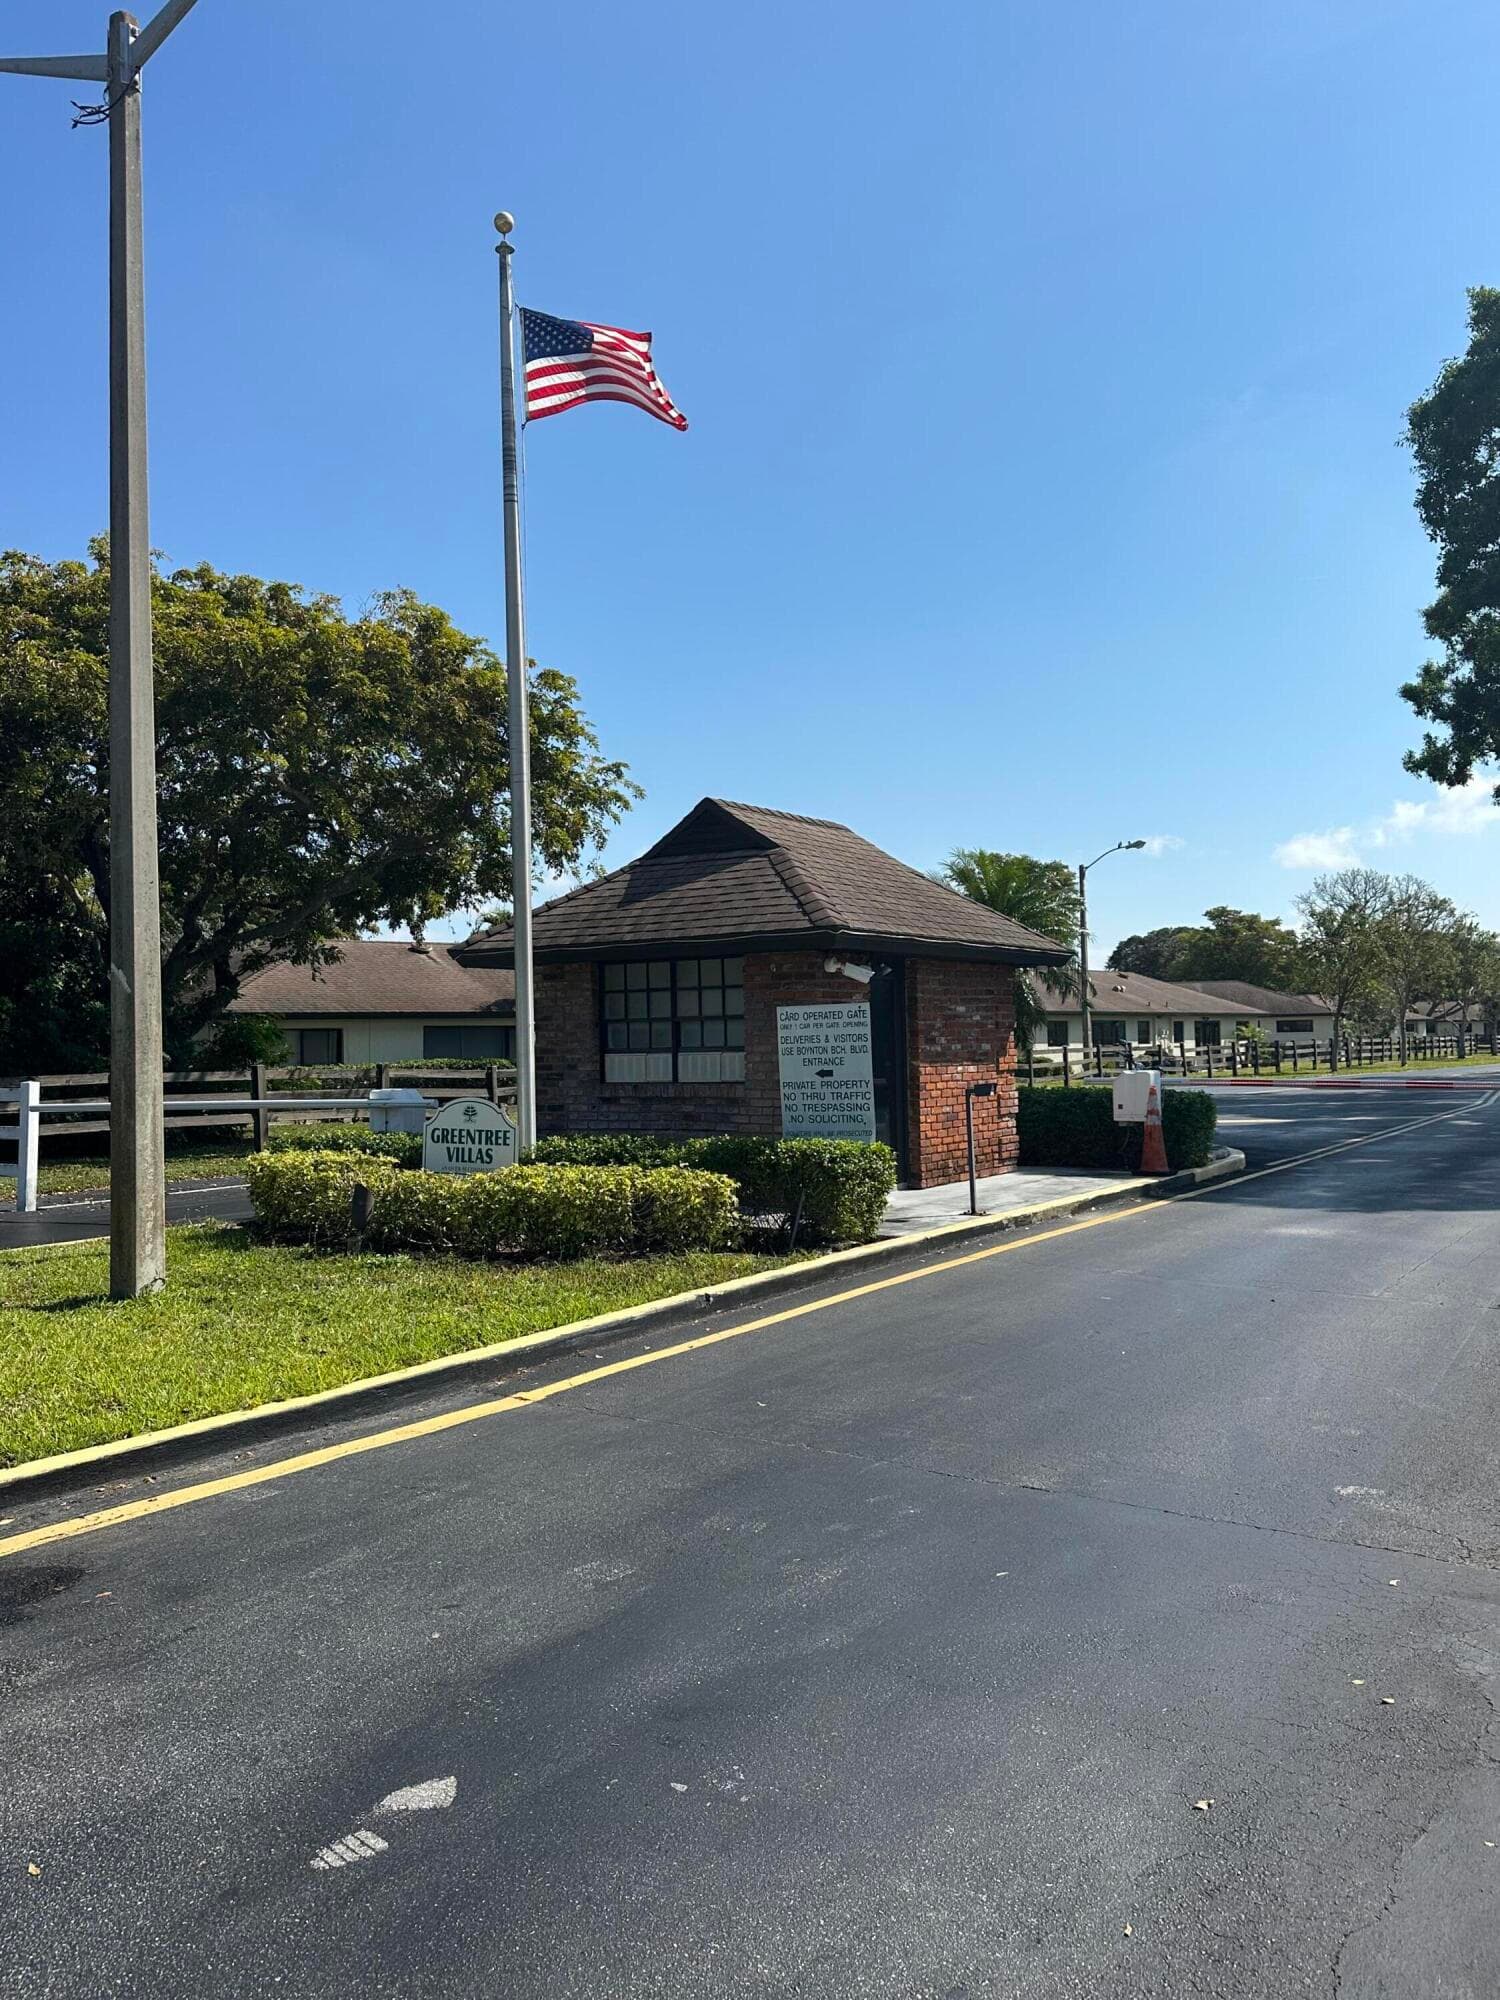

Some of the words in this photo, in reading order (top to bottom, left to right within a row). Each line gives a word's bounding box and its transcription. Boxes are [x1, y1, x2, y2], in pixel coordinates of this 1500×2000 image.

[780, 1012, 799, 1021] CARD
[803, 1011, 843, 1020] OPERATED
[847, 1010, 867, 1019] GATE
[780, 1035, 820, 1044] DELIVERIES
[825, 1034, 830, 1043] &
[833, 1033, 868, 1043] VISITORS
[782, 1047, 794, 1055] USE
[797, 1046, 828, 1055] BOYNTON
[803, 1057, 845, 1066] ENTRANCE
[783, 1081, 816, 1089] PRIVATE
[821, 1080, 870, 1089] PROPERTY
[784, 1092, 797, 1101] NO
[801, 1092, 825, 1101] THRU
[830, 1091, 871, 1100] TRAFFIC
[785, 1104, 798, 1112] NO
[802, 1102, 870, 1112] TRESPASSING
[790, 1115, 804, 1123] NO
[431, 1127, 510, 1146] GREENTREE
[446, 1146, 493, 1164] VILLAS
